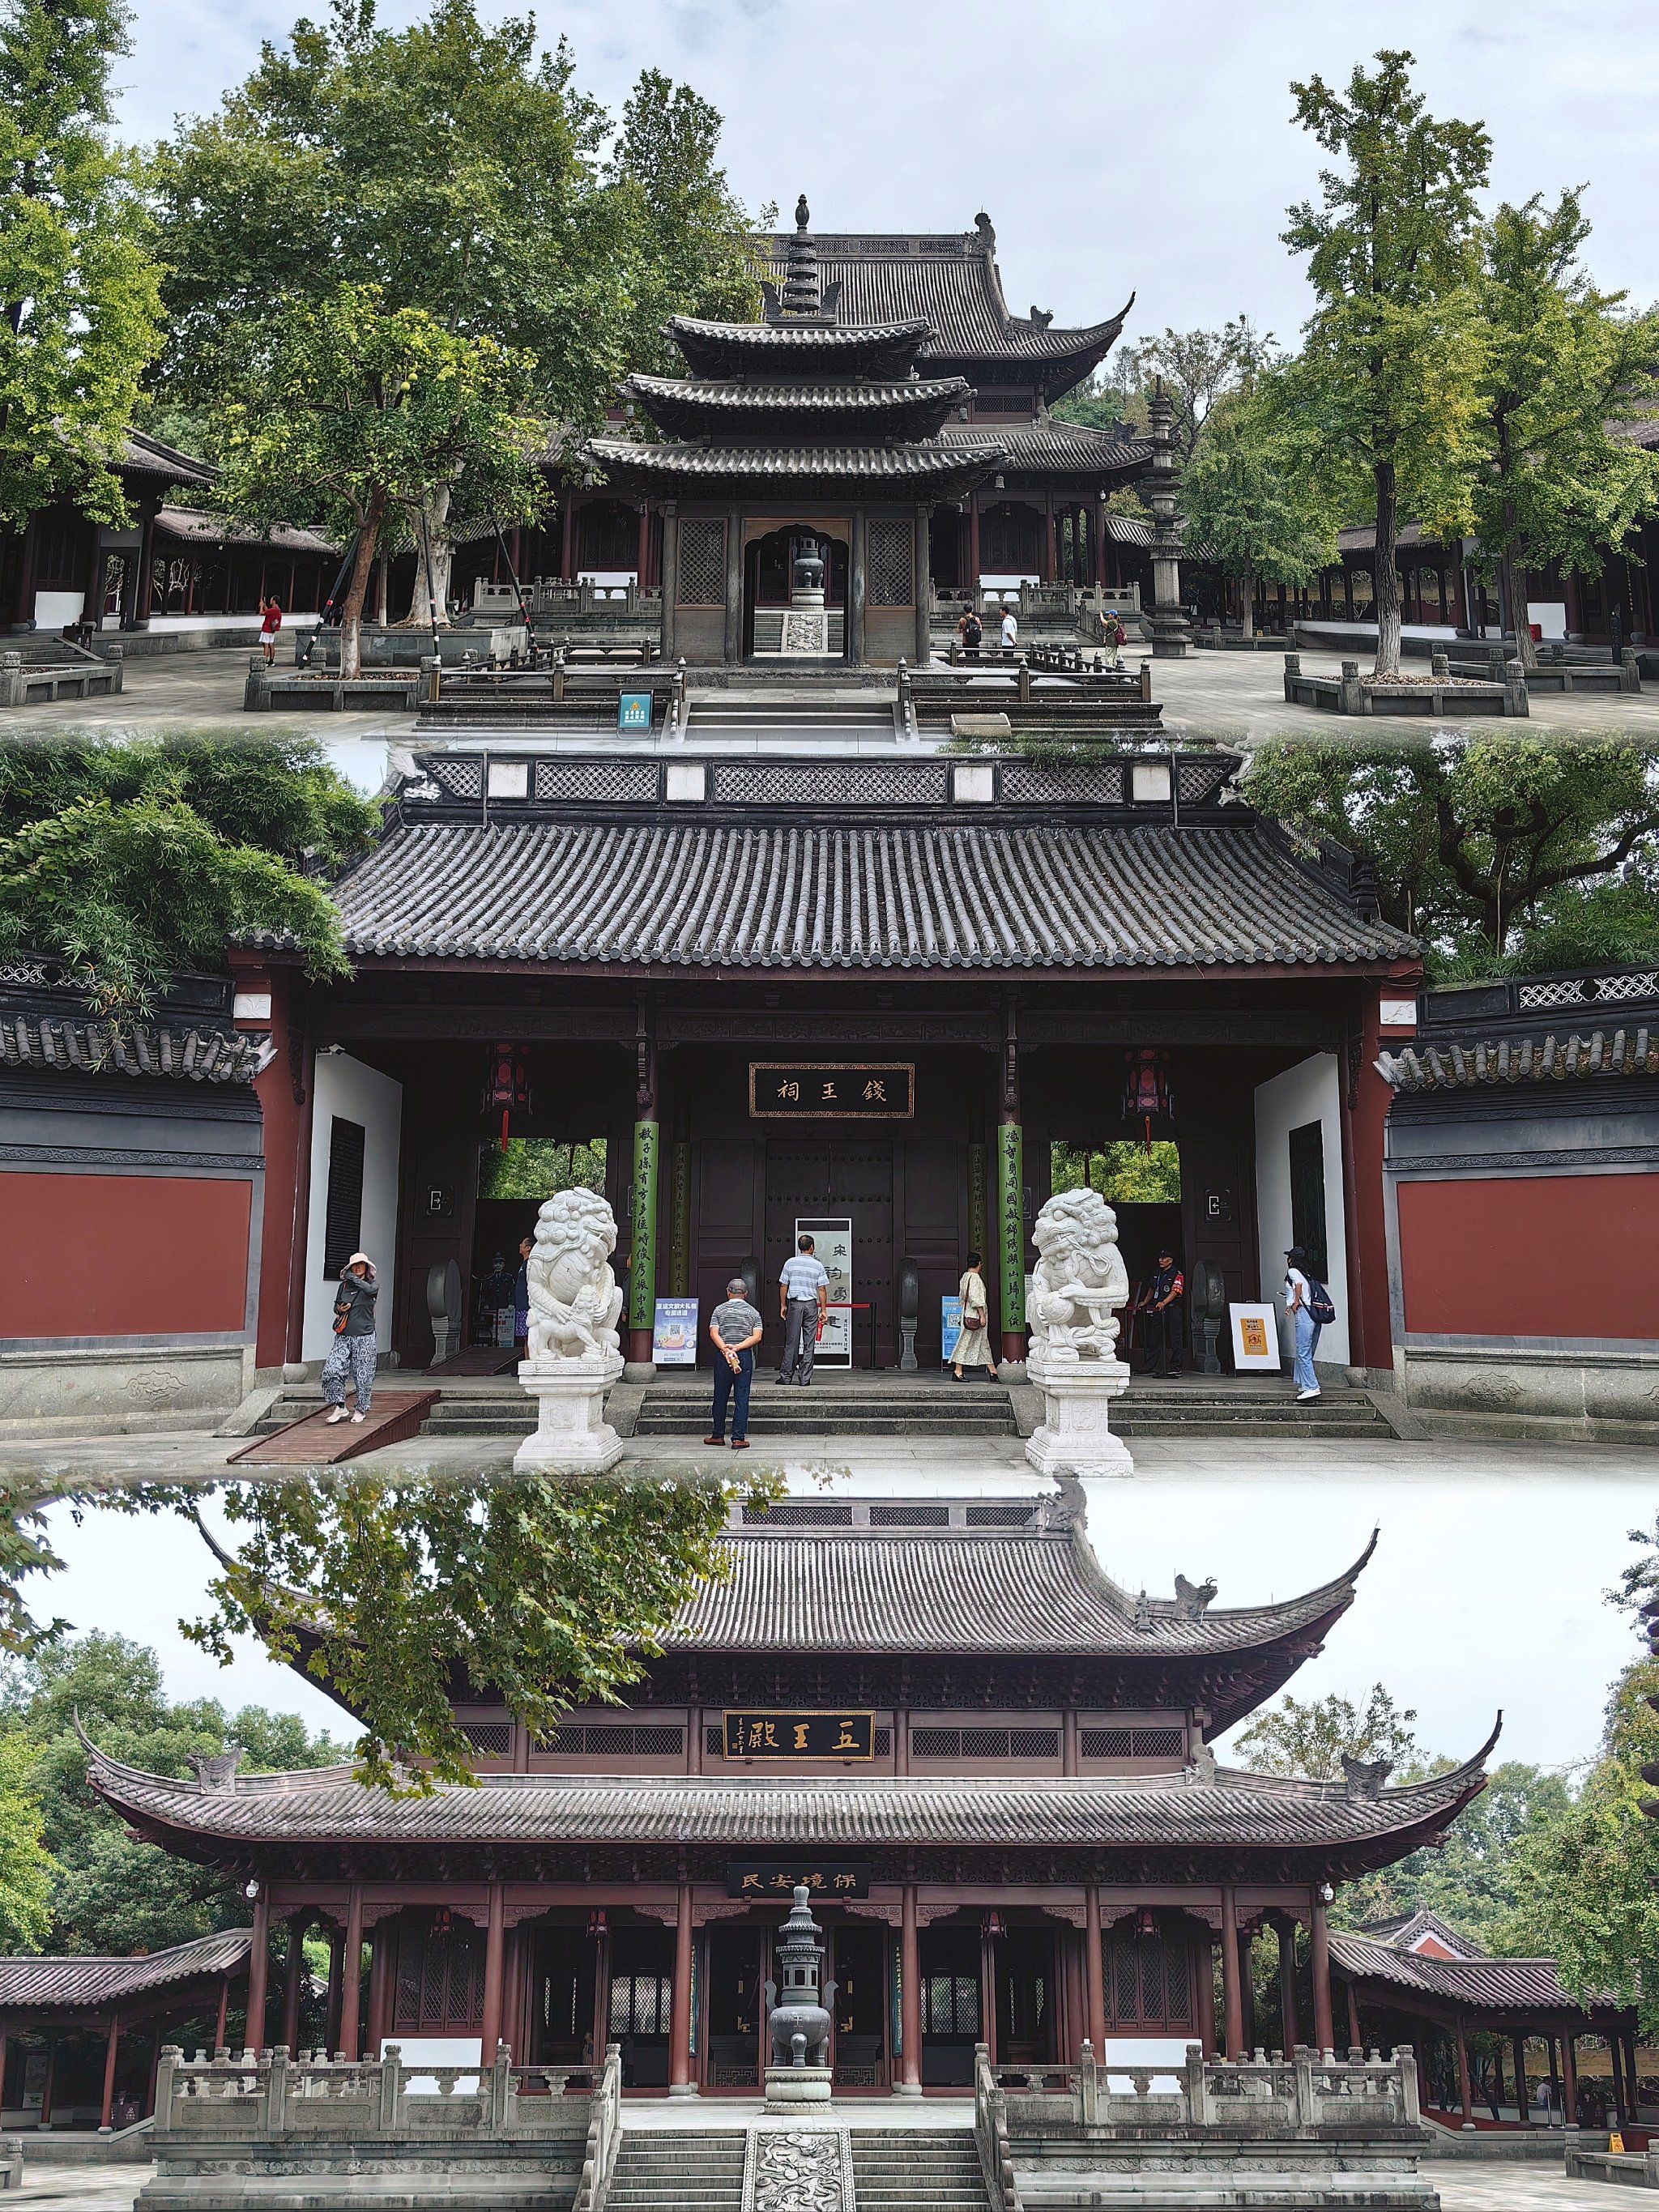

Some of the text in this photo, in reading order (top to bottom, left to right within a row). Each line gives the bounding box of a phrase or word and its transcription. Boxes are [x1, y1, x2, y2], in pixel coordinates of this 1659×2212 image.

[777, 1080, 888, 1102] 錢王祠
[741, 1872, 856, 1889] 保境安民
